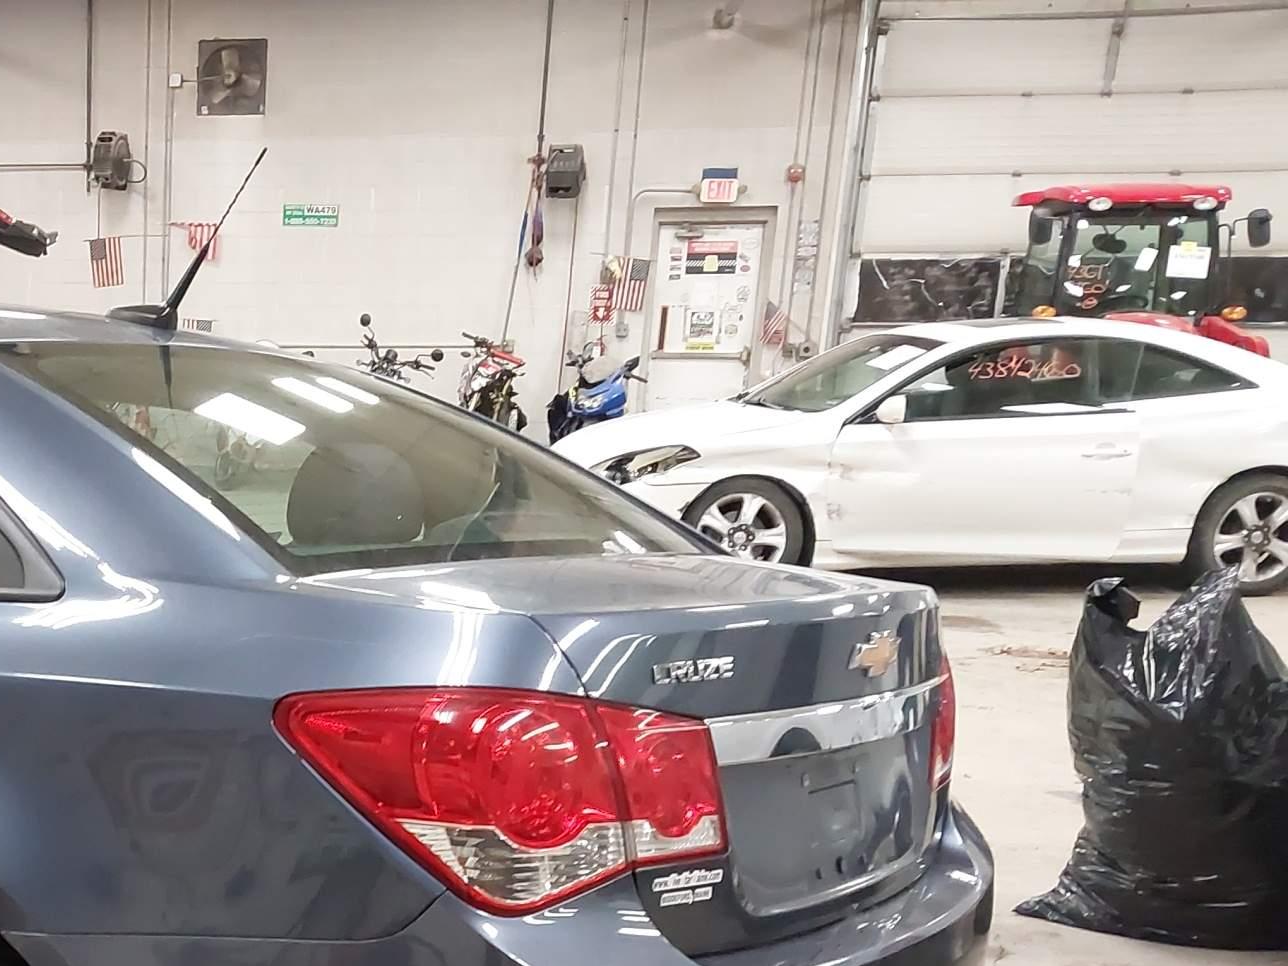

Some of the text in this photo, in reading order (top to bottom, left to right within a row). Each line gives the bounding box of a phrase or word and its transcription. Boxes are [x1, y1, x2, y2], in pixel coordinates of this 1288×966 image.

[708, 180, 734, 200] EXIT
[306, 206, 337, 214] WA479
[652, 656, 734, 684] CRUZE
